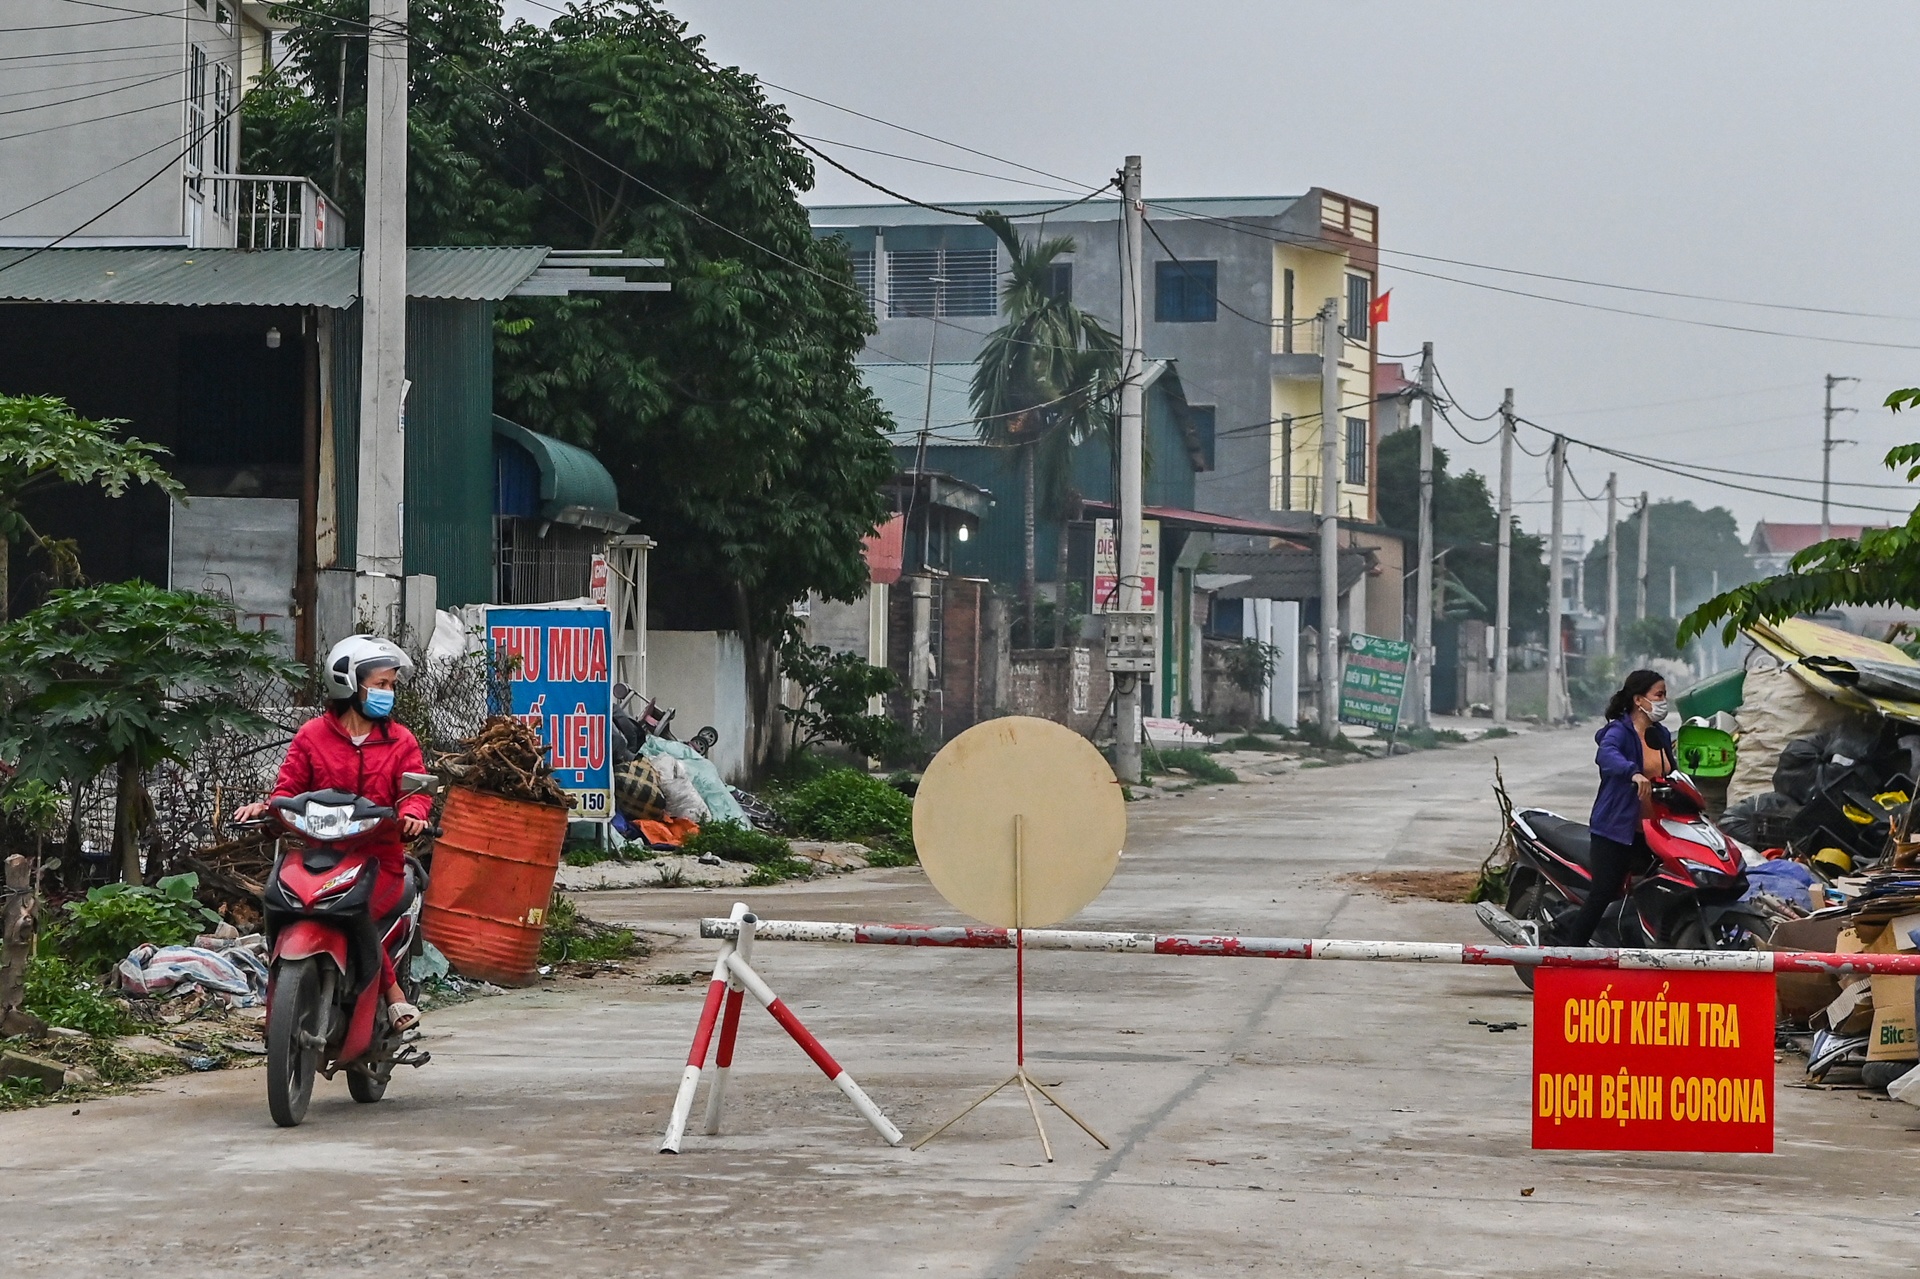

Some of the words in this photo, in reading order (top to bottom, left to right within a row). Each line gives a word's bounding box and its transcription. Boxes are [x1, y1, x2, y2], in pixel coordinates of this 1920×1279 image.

[491, 626, 541, 682] THU
[547, 627, 608, 683] MUA
[1344, 699, 1371, 712] TRANG
[550, 702, 606, 782] LIỆU
[581, 793, 605, 810] 150
[1564, 984, 1624, 1044] CHỐT
[1630, 981, 1690, 1047] KIỂM
[1697, 1002, 1740, 1048] TRA
[1539, 1073, 1593, 1126] DỊCH
[1600, 1066, 1663, 1127] BỆNH
[1670, 1076, 1766, 1124] CORONA
